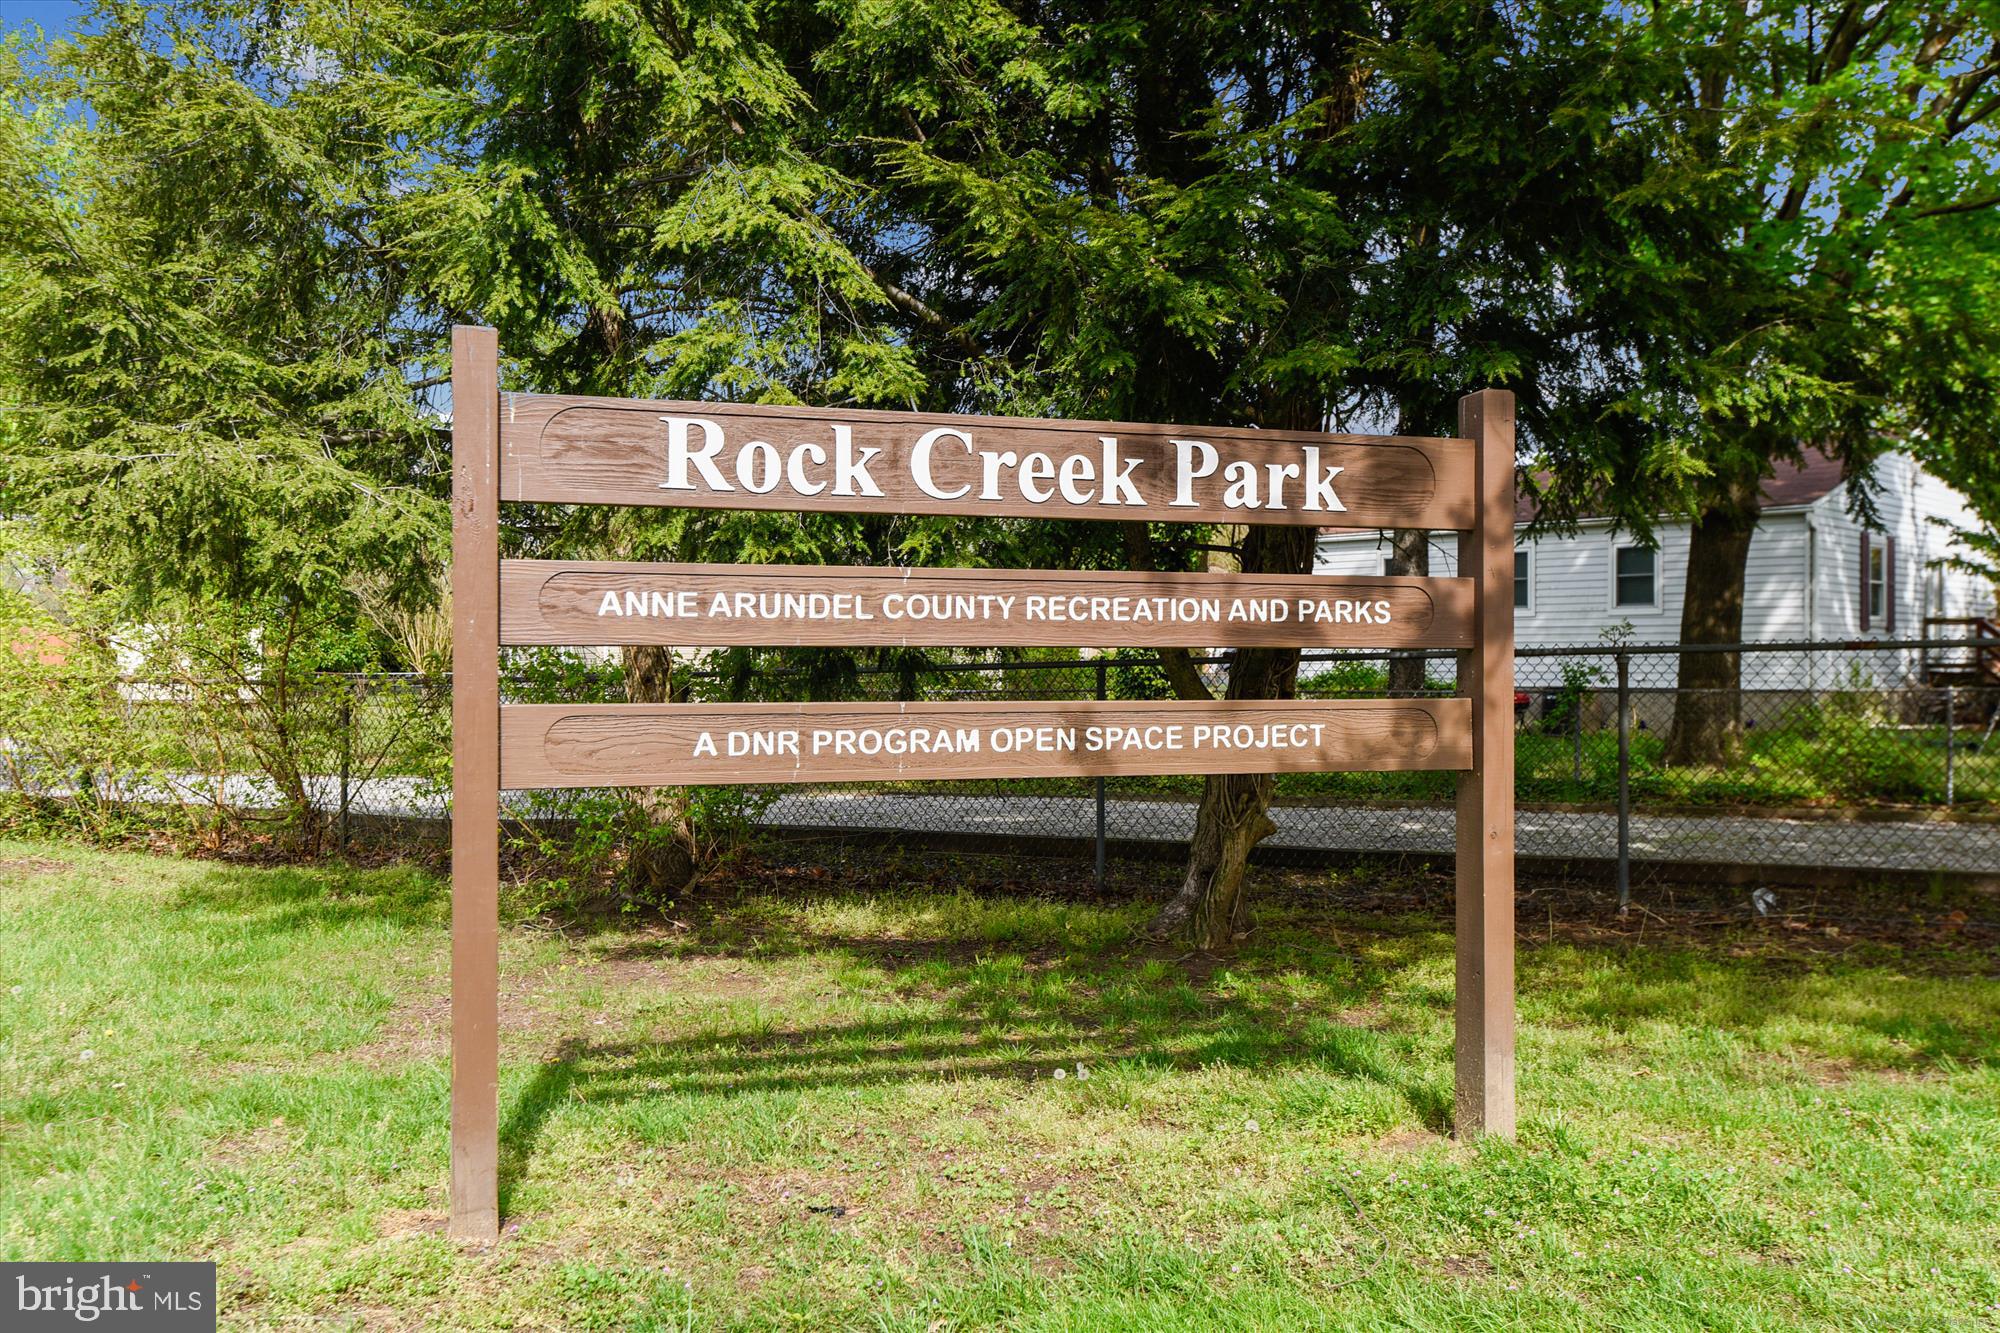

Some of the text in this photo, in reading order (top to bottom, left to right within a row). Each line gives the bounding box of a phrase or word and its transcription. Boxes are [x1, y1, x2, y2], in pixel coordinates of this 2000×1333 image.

[659, 416, 1348, 512] Rock Creek Park
[598, 590, 1392, 625] ANNE ARUNDEL COUNTY RECREATION AND PARKS
[693, 723, 1326, 757] A DNR PROGRAM OPEN SPACE PROJECT
